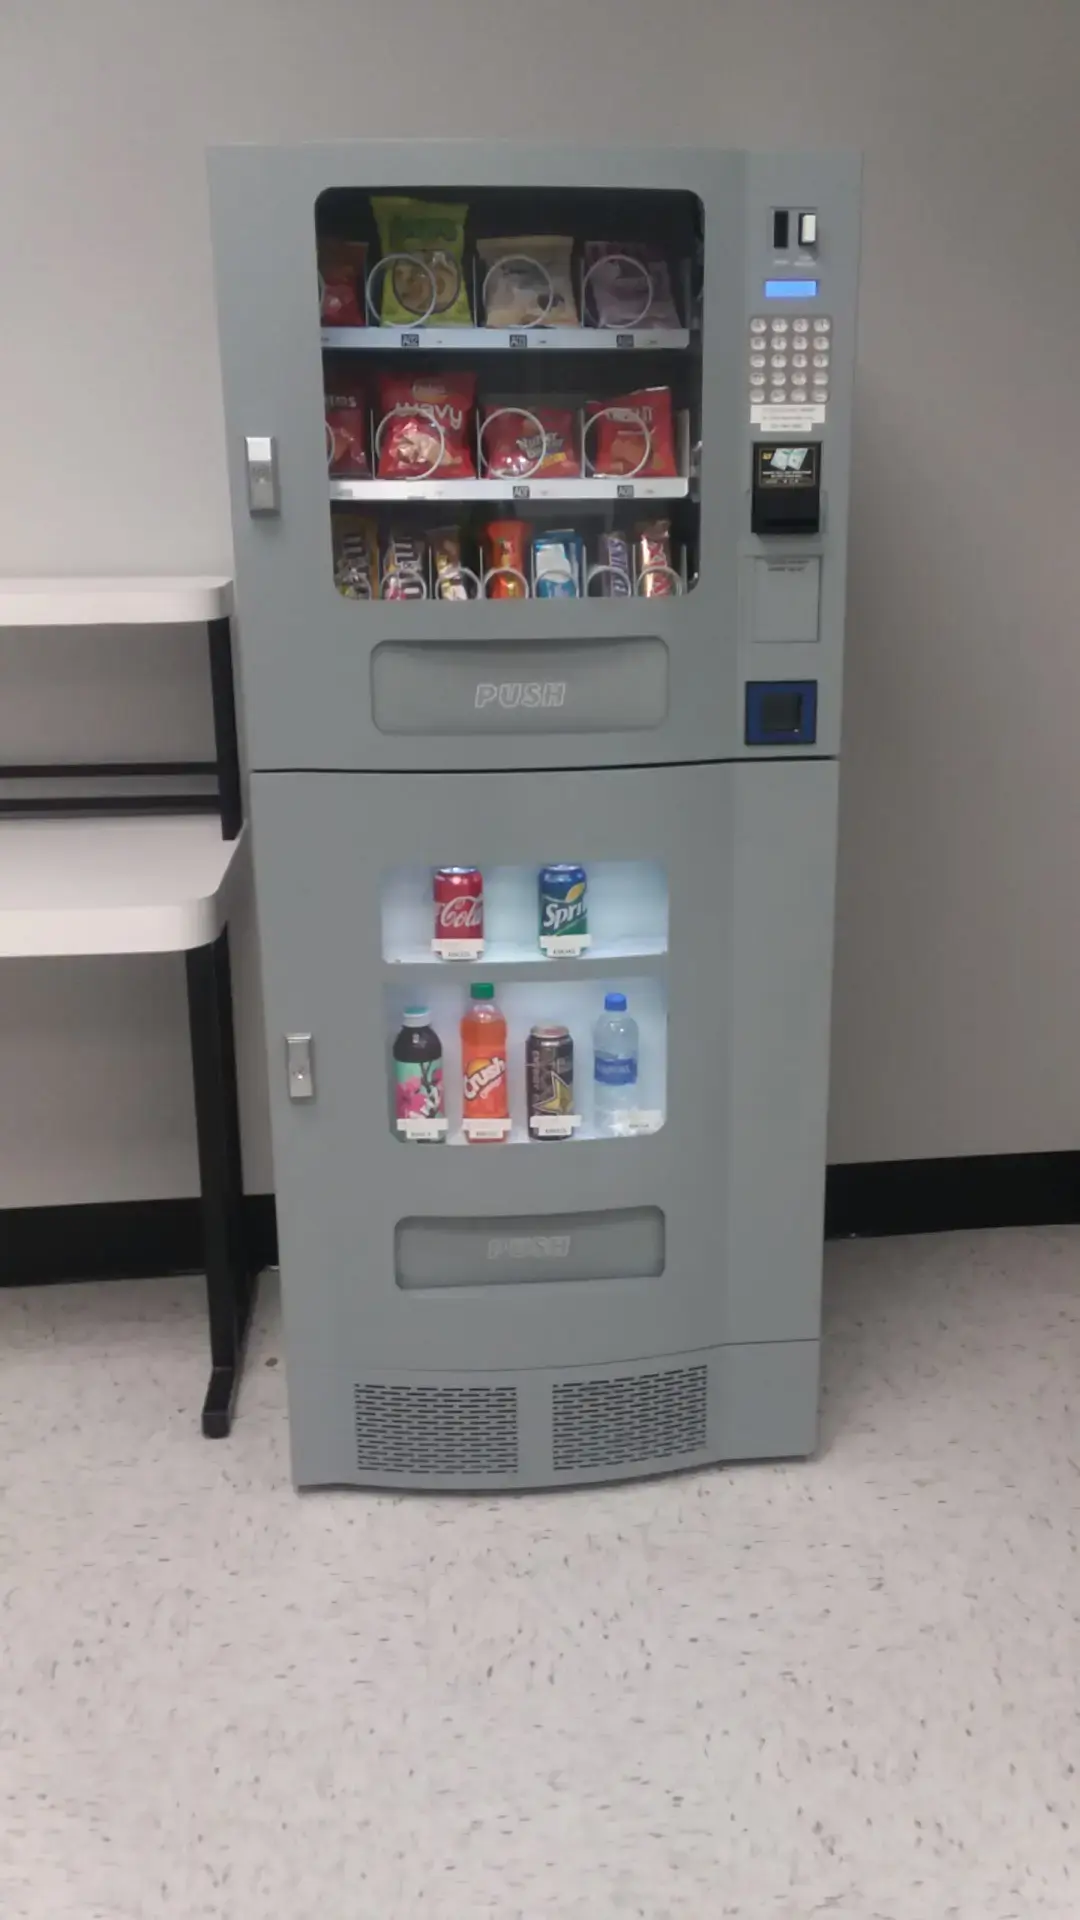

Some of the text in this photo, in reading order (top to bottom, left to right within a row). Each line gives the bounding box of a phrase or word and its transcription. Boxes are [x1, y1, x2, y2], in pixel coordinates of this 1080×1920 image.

[475, 682, 566, 708] PUSH
[464, 1057, 506, 1099] Crush
[486, 1235, 571, 1260] PUSH
